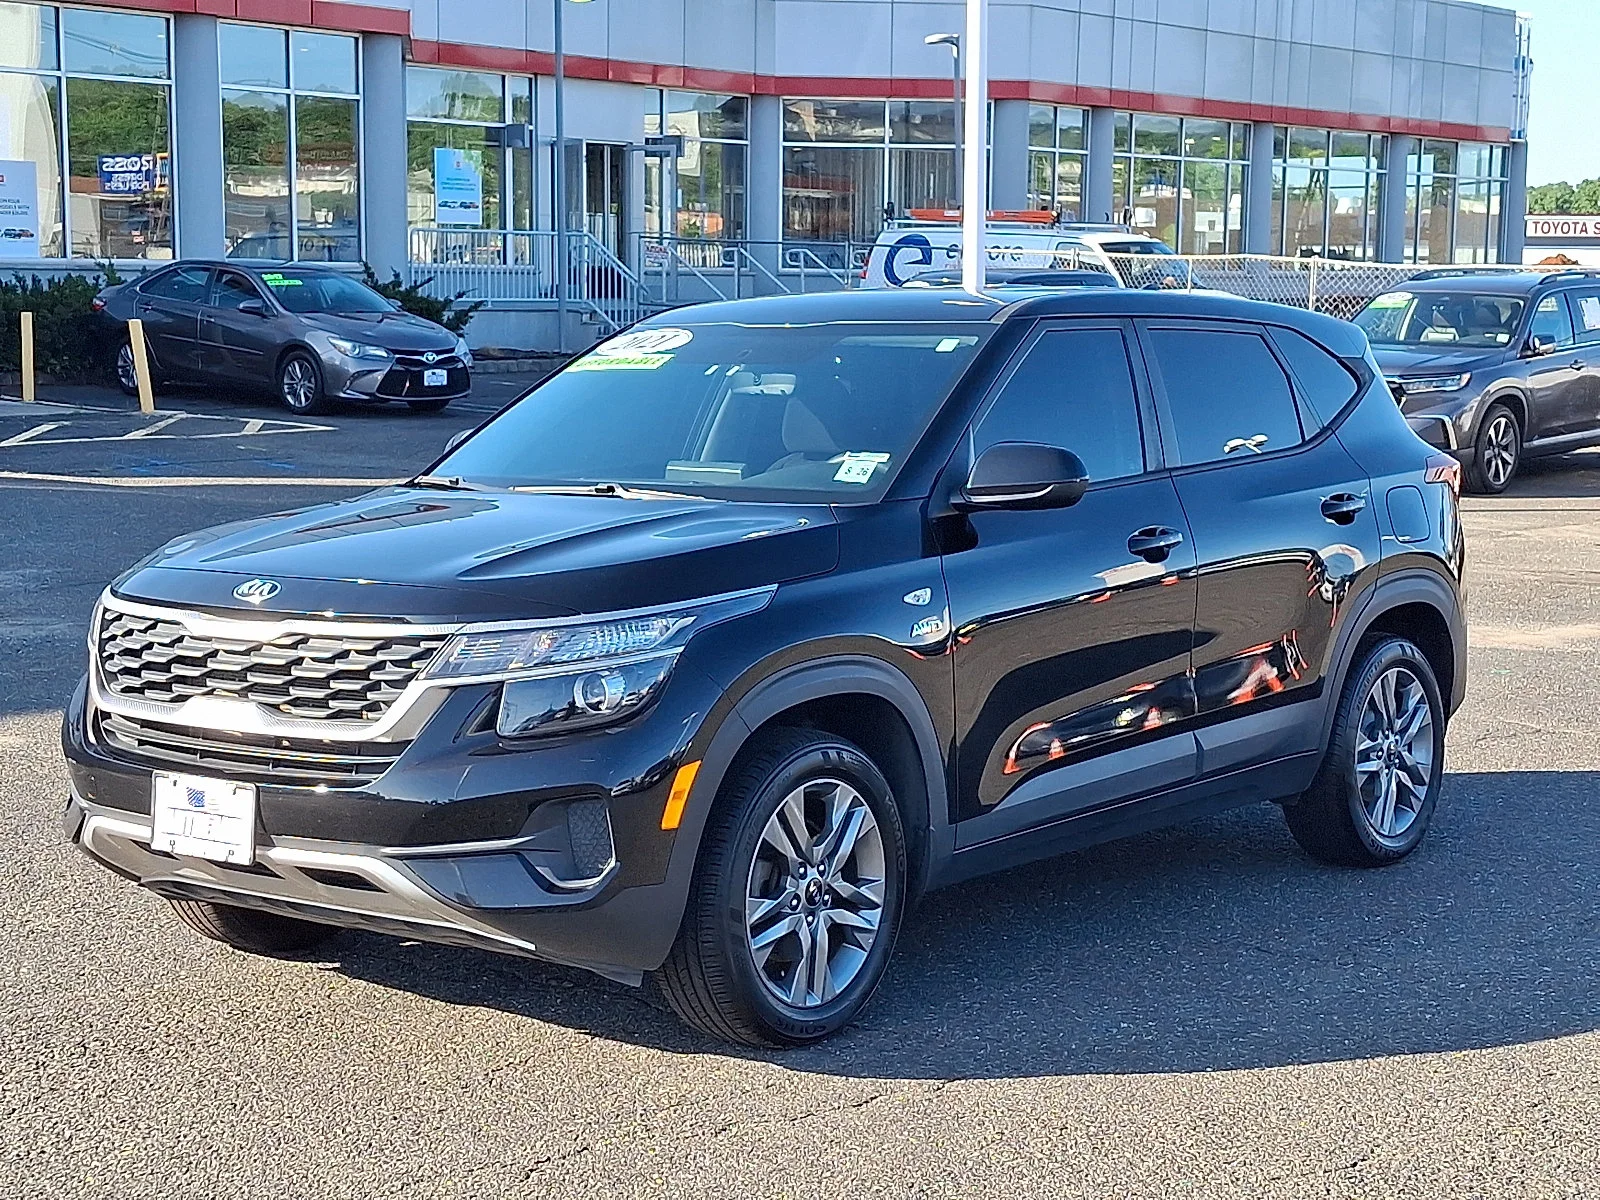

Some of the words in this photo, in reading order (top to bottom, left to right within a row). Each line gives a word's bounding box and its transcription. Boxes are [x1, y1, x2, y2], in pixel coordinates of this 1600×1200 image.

[1532, 221, 1588, 235] TOYOTA
[237, 580, 274, 597] KIA
[911, 619, 943, 638] AWD
